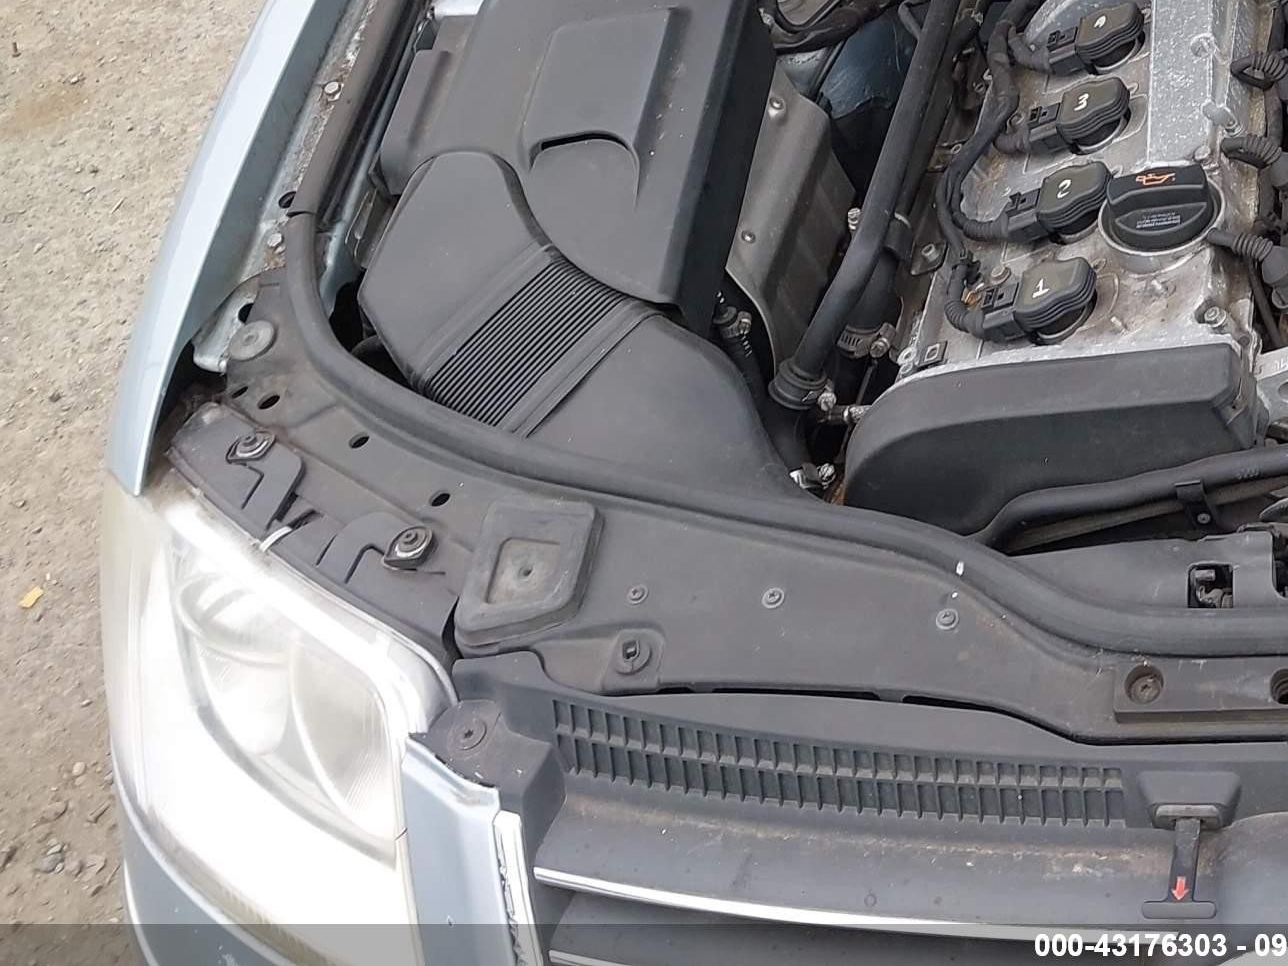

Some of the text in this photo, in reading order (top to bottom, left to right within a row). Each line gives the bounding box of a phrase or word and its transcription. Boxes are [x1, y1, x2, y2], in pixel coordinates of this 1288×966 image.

[1073, 92, 1090, 112] 3
[1056, 179, 1072, 199] 2
[1031, 278, 1050, 298] 1
